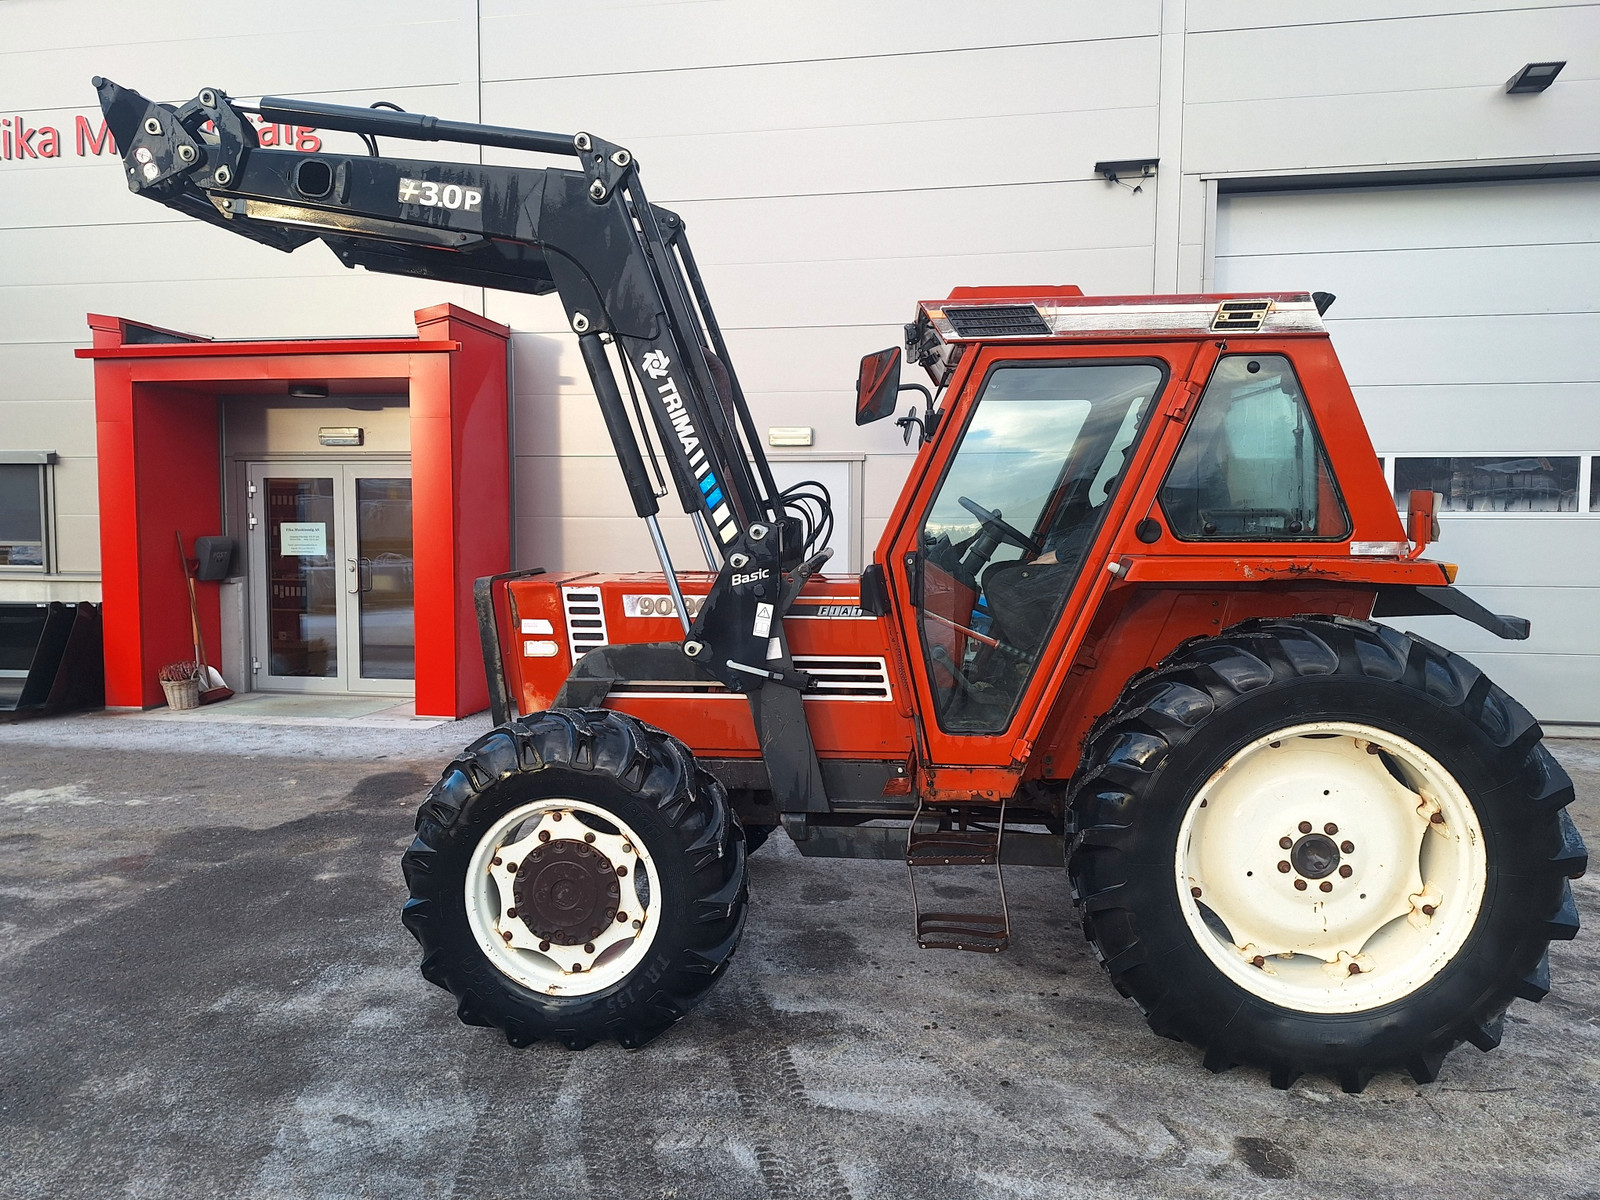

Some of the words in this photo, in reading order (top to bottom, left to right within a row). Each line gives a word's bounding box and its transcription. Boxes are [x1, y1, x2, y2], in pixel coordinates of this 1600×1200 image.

[0, 116, 60, 160] ika
[657, 377, 703, 456] TRIMA
[732, 569, 770, 587] Basic
[819, 606, 862, 615] FIAT
